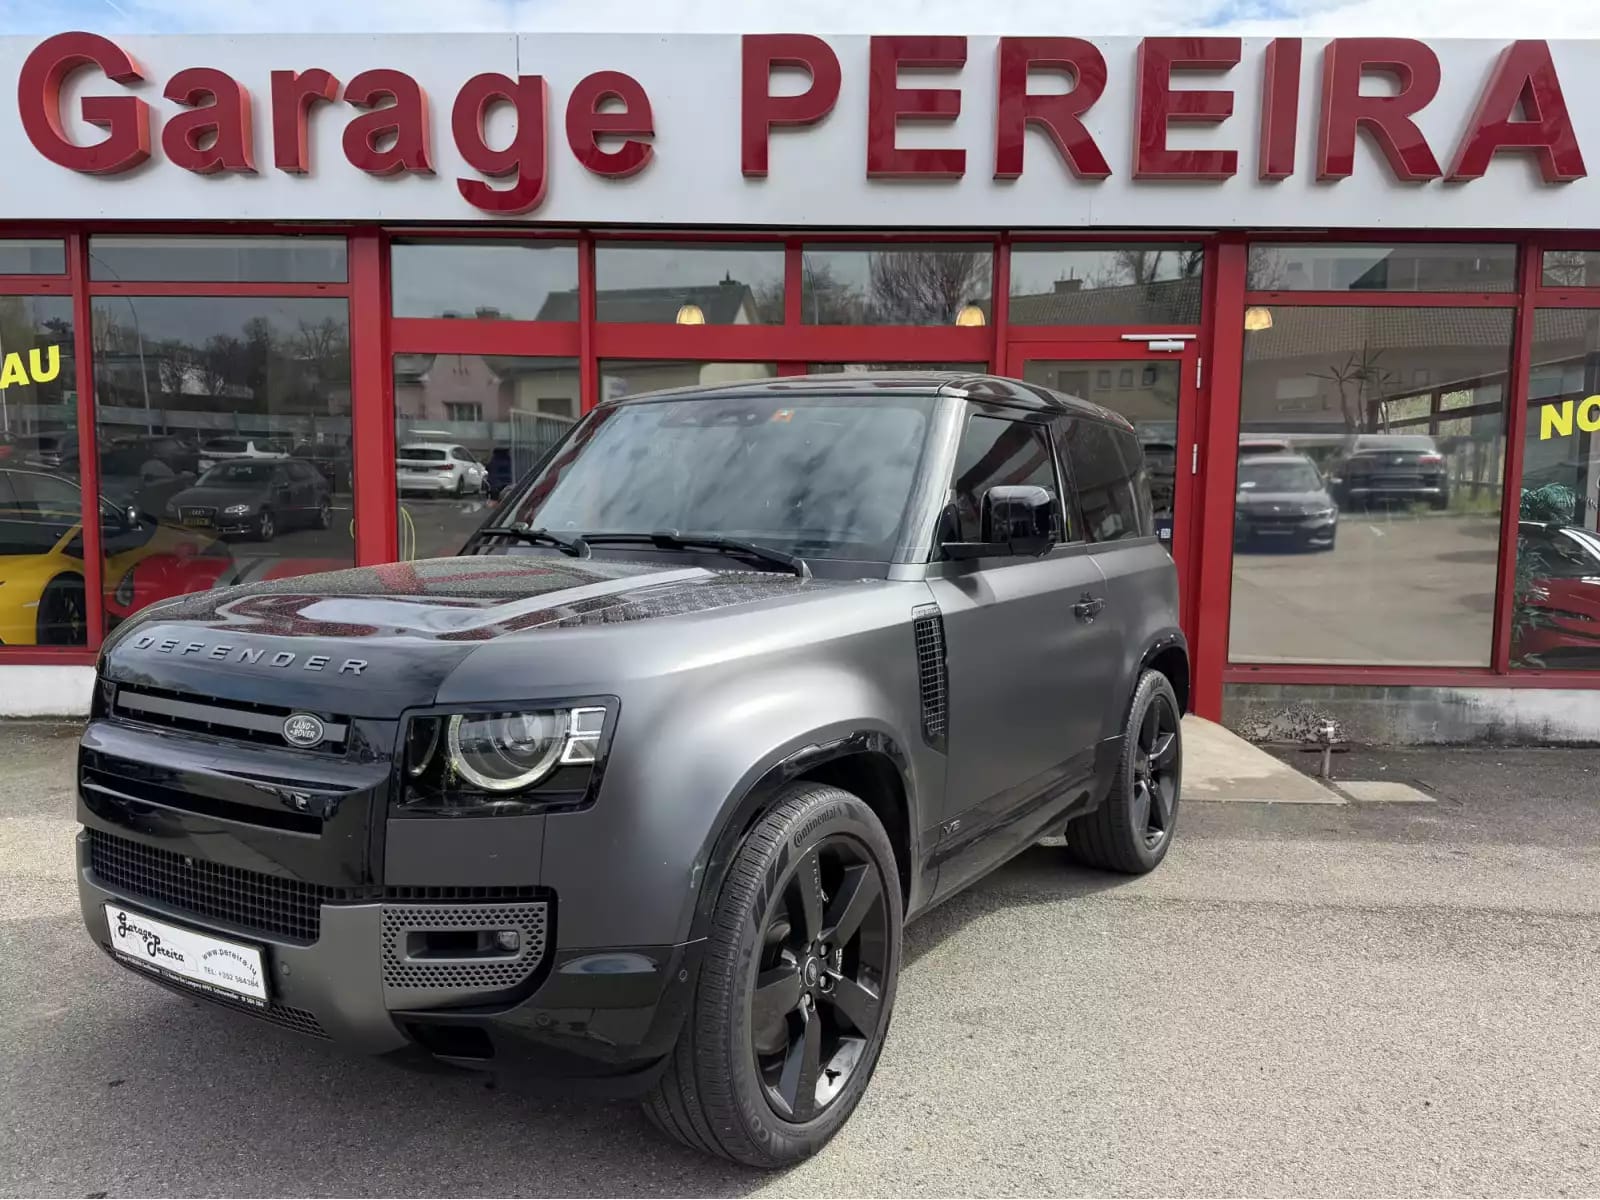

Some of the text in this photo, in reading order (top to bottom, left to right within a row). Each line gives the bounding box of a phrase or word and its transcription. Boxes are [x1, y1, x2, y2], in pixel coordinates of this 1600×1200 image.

[18, 31, 1586, 215] Garage PEREIRA
[0, 345, 60, 389] AU
[134, 637, 368, 675] DEFENDER
[117, 911, 153, 942] Garage
[147, 934, 185, 963] Pereira
